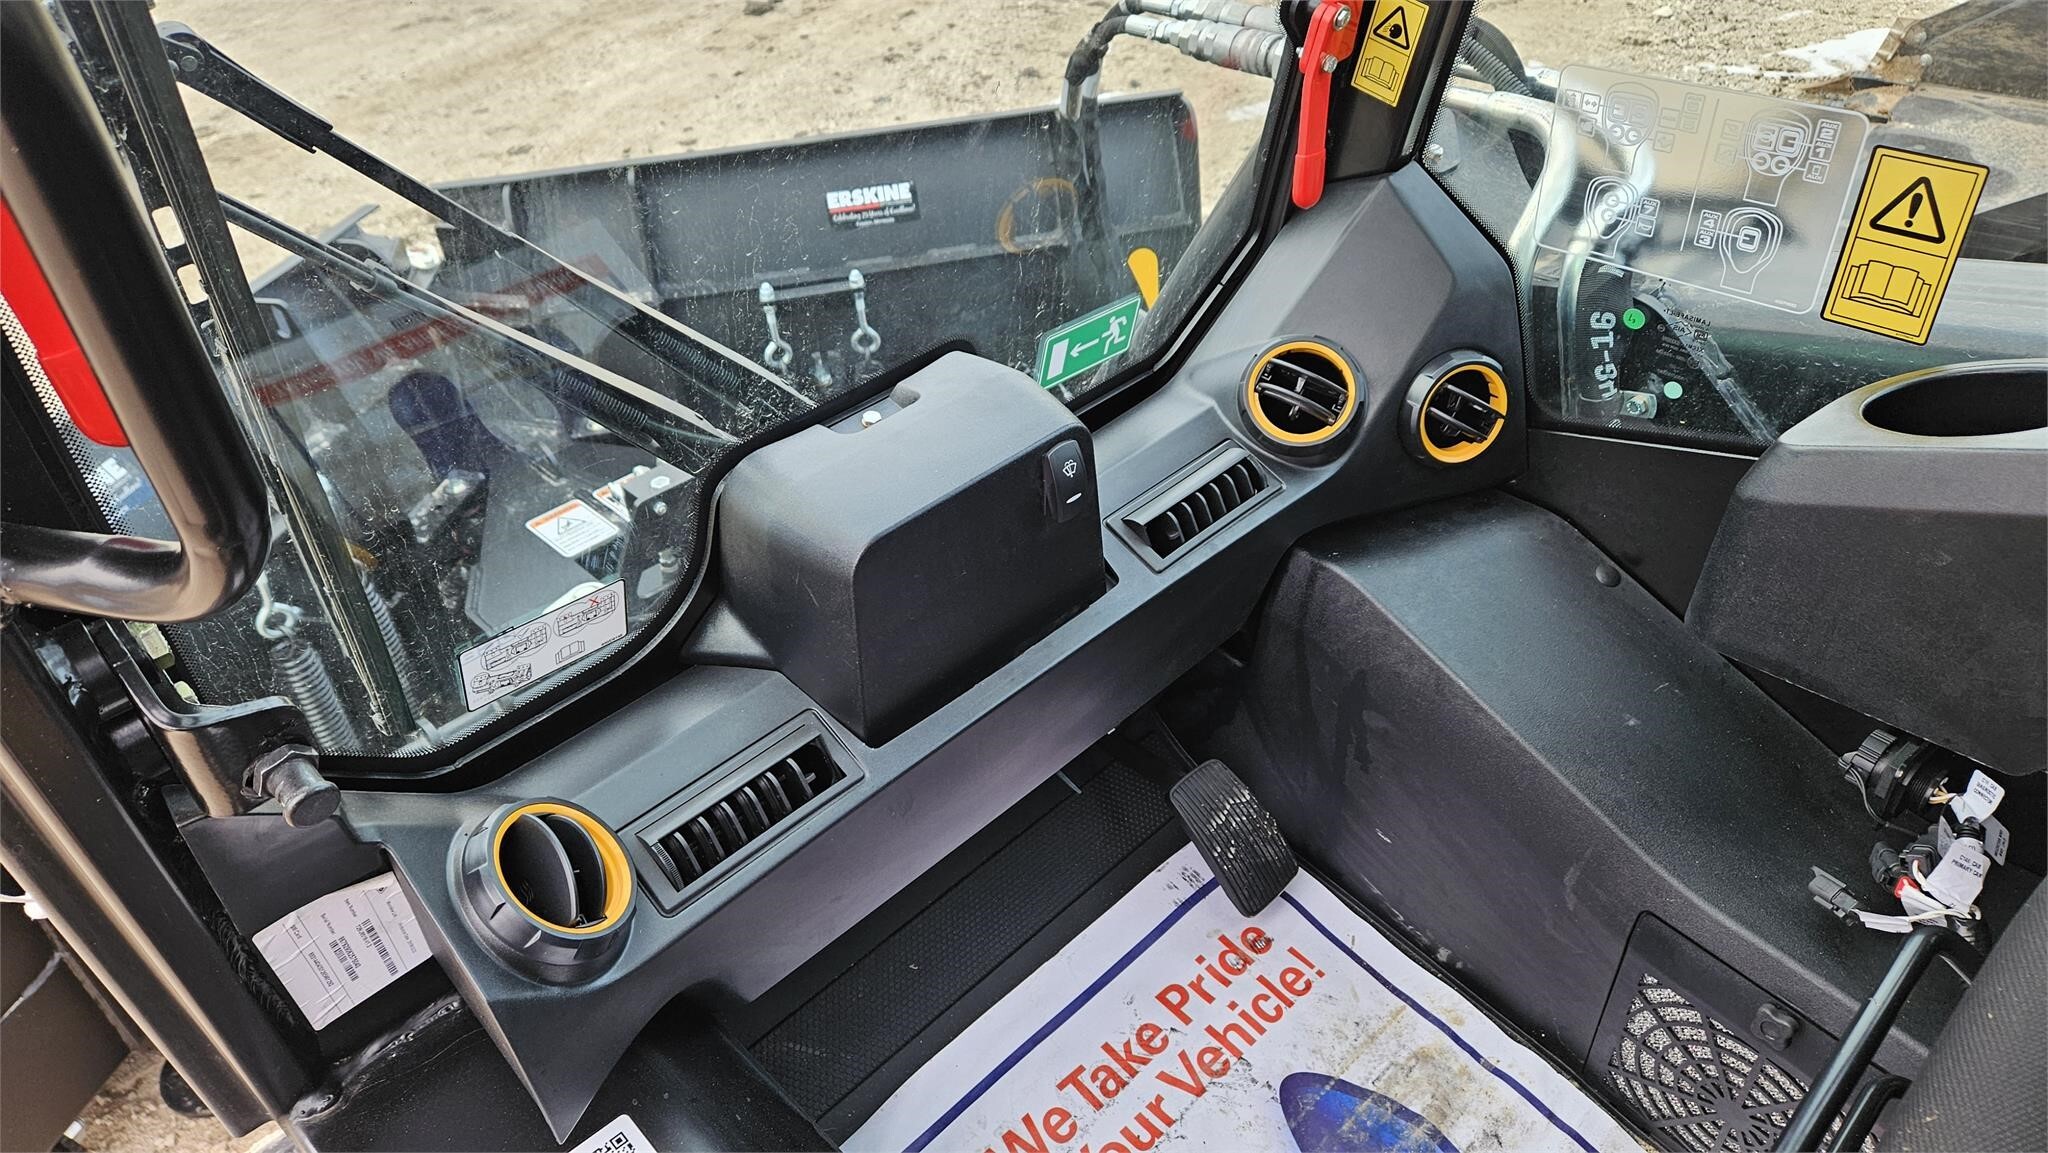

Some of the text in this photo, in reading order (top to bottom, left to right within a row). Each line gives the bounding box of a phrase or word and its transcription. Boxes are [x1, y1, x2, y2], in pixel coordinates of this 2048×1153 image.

[1820, 122, 1838, 130] AUX
[1820, 129, 1834, 140] 2
[1815, 141, 1833, 149] AUX
[1815, 148, 1826, 159] 1
[826, 181, 913, 210] ERSKINE
[1703, 212, 1719, 220] AUX
[1703, 219, 1715, 229] 4
[1699, 229, 1714, 237] AUX
[1698, 235, 1711, 246] 3
[1056, 1022, 1169, 1112] Take
[1155, 926, 1274, 1026] Pride
[1155, 946, 1326, 1098] Vehicle!
